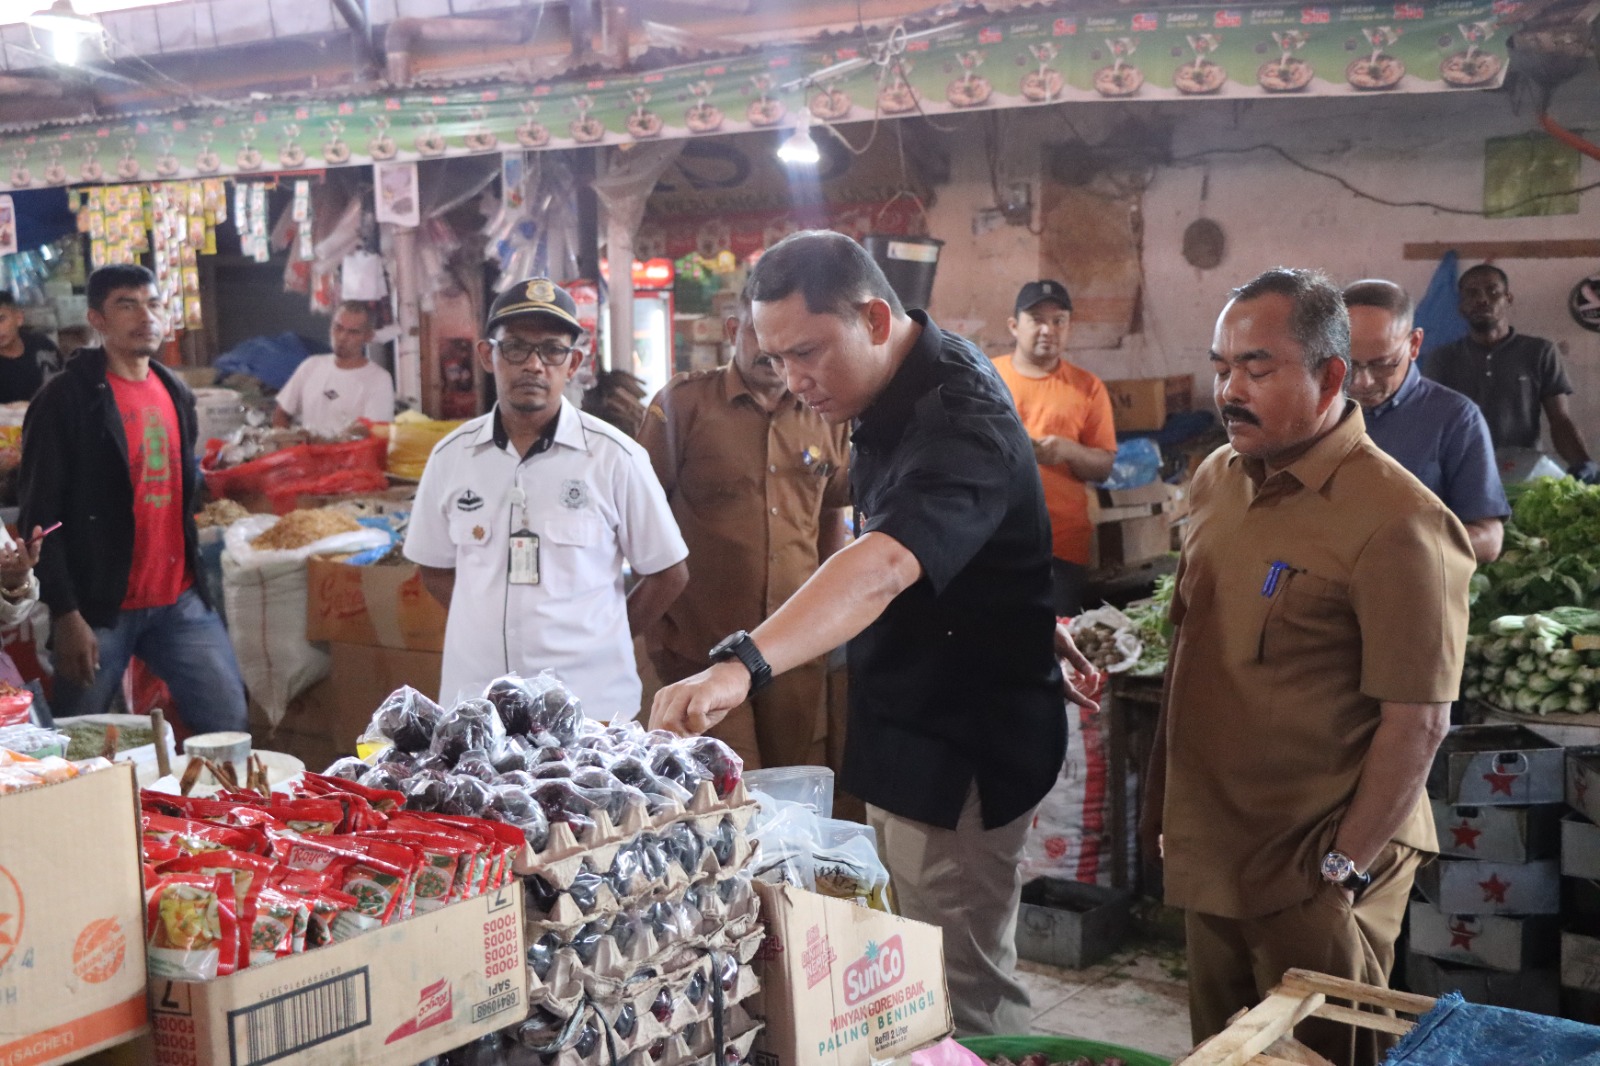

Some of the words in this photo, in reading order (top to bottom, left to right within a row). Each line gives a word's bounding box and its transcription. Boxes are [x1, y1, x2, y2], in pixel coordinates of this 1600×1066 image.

[483, 912, 516, 935] FOODS
[484, 926, 517, 949] FOODS
[485, 940, 518, 964] FOODS
[485, 954, 519, 979] FOODS
[846, 946, 901, 1001] SunCo
[488, 978, 511, 997] SAPI
[418, 990, 449, 1017] Royco
[830, 1006, 868, 1033] MINYAK
[868, 989, 905, 1017] GORENG
[905, 980, 926, 1000] BAIK
[151, 1015, 195, 1034] FOODS
[9, 1030, 75, 1066] (SACHET)
[153, 1032, 196, 1050] FOODS
[818, 1021, 869, 1057] PALING
